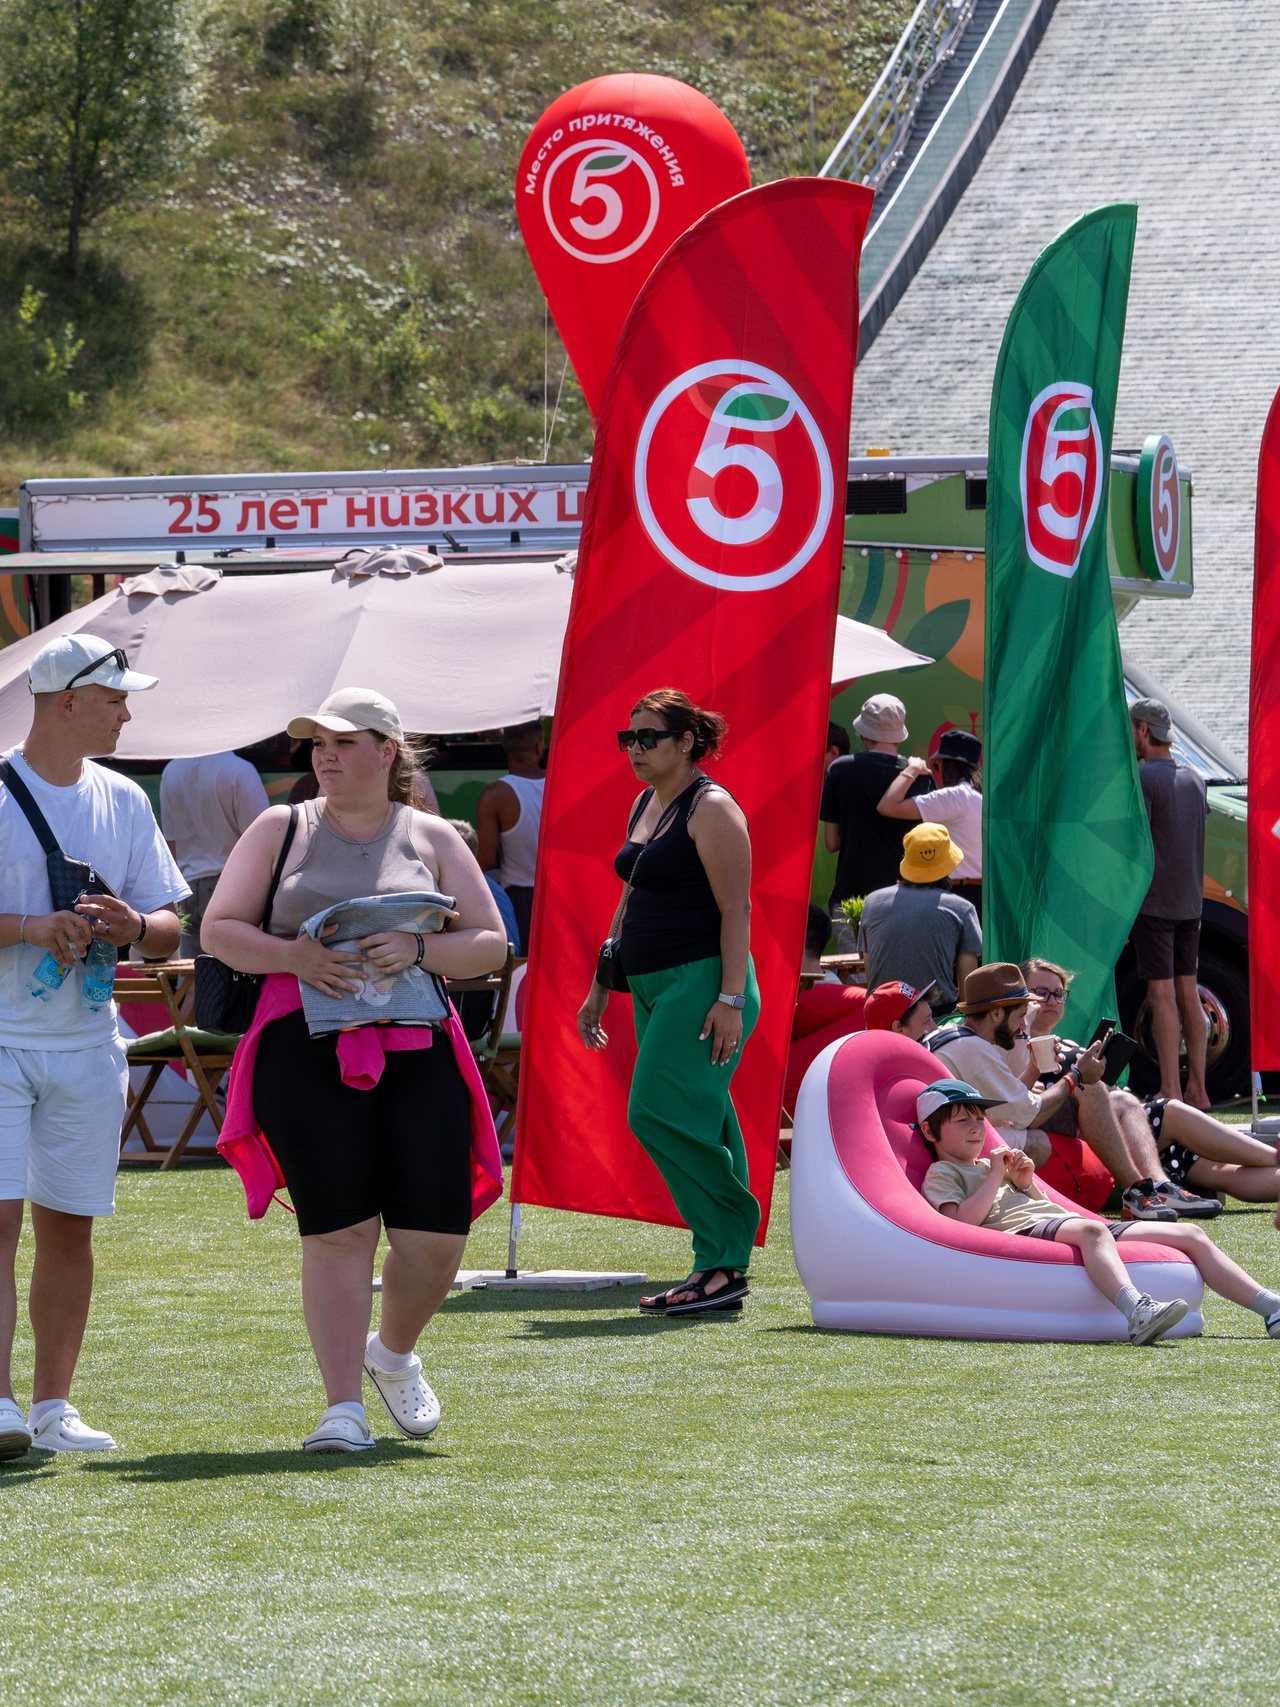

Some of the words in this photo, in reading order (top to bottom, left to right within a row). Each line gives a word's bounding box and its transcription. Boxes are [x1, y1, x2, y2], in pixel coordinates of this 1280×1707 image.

[525, 128, 564, 195] Место
[569, 113, 685, 188] притяжения
[569, 149, 631, 240] 5
[168, 494, 220, 534] 25
[237, 498, 329, 532] лет
[346, 490, 539, 528] низких
[687, 382, 792, 545] 5
[1038, 399, 1091, 539] 5
[1158, 449, 1176, 554] 5
